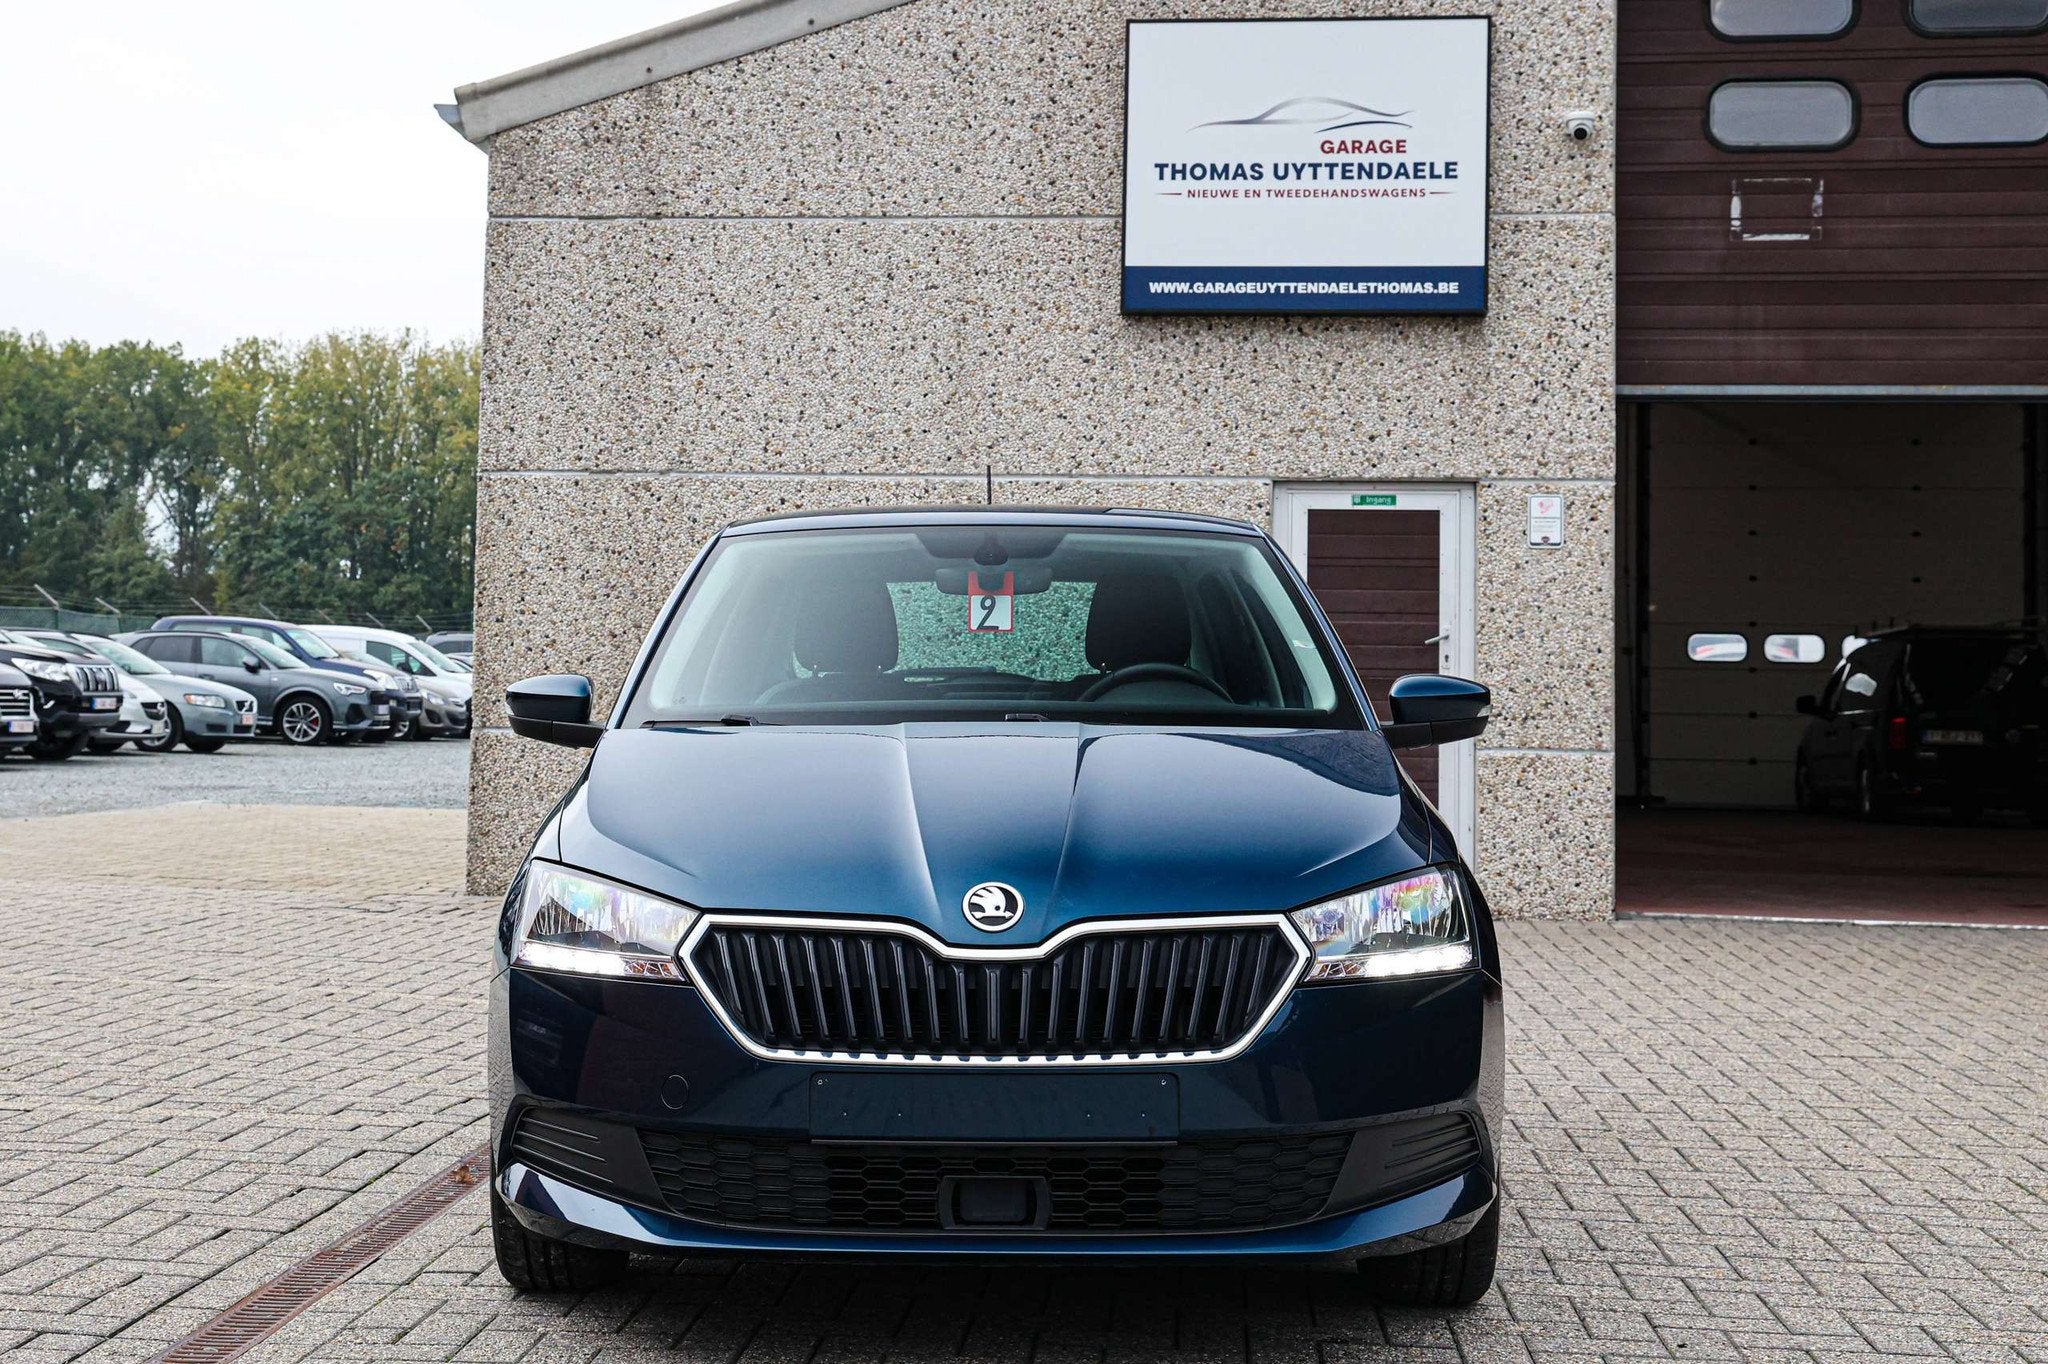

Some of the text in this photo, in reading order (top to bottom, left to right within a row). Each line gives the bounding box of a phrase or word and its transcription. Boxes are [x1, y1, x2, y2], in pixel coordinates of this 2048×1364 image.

[1320, 139, 1407, 154] GARAGE
[1154, 161, 1459, 181] THOMAS UYTTENDAELE
[1187, 187, 1426, 198] NIEUWE EN TWEEDEHANDSWAGENS
[1149, 281, 1459, 294] WWW.GARAGEUYTTENDAELETHOMAS.BE
